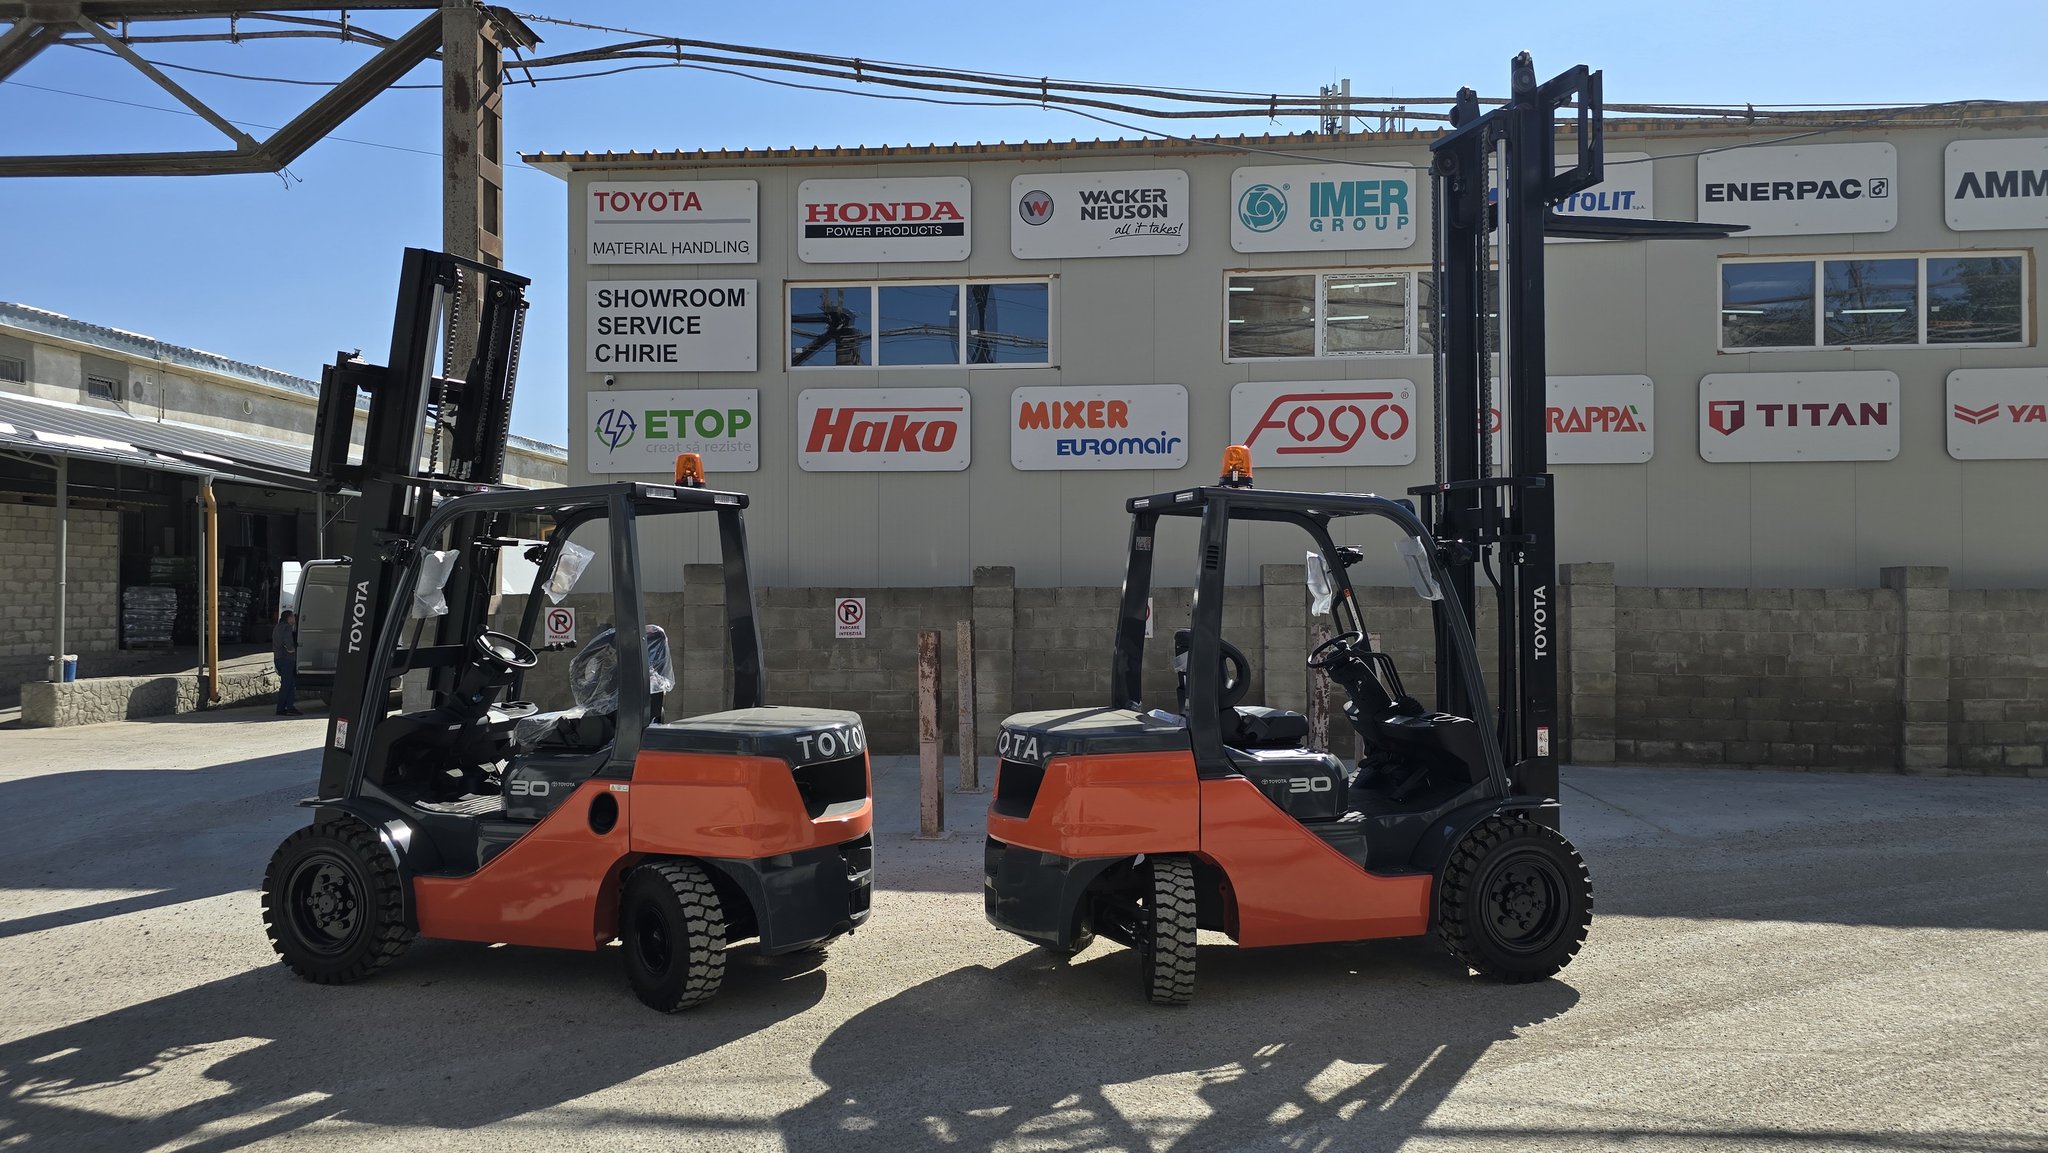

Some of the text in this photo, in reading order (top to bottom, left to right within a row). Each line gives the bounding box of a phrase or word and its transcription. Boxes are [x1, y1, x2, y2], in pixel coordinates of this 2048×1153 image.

[1079, 188, 1168, 204] WACKER
[1310, 180, 1409, 216] IMER
[1705, 179, 1862, 202] ENERPAC
[594, 191, 702, 213] TOYOTA
[805, 202, 964, 223] HONDA
[1080, 203, 1168, 220] NEUSON
[826, 225, 943, 237] POWER PRODUCTS
[1115, 222, 1183, 234] all it takes!
[1310, 215, 1409, 232] GROUP
[593, 240, 749, 256] MATERIAL HANDLING
[597, 288, 746, 309] SHOWROOM
[597, 316, 701, 336] SERVICE
[595, 343, 678, 364] CHIRIE
[645, 409, 752, 439] ETOP
[1019, 400, 1128, 429] MIXER
[1756, 402, 1888, 427] TITAN
[805, 407, 963, 453] Hako
[646, 442, 682, 454] creat
[705, 441, 751, 453] reziste
[348, 580, 370, 653] TOYOTA
[1533, 585, 1547, 660] TOYOTA
[510, 780, 550, 797] 30
[1289, 776, 1332, 793] 30
